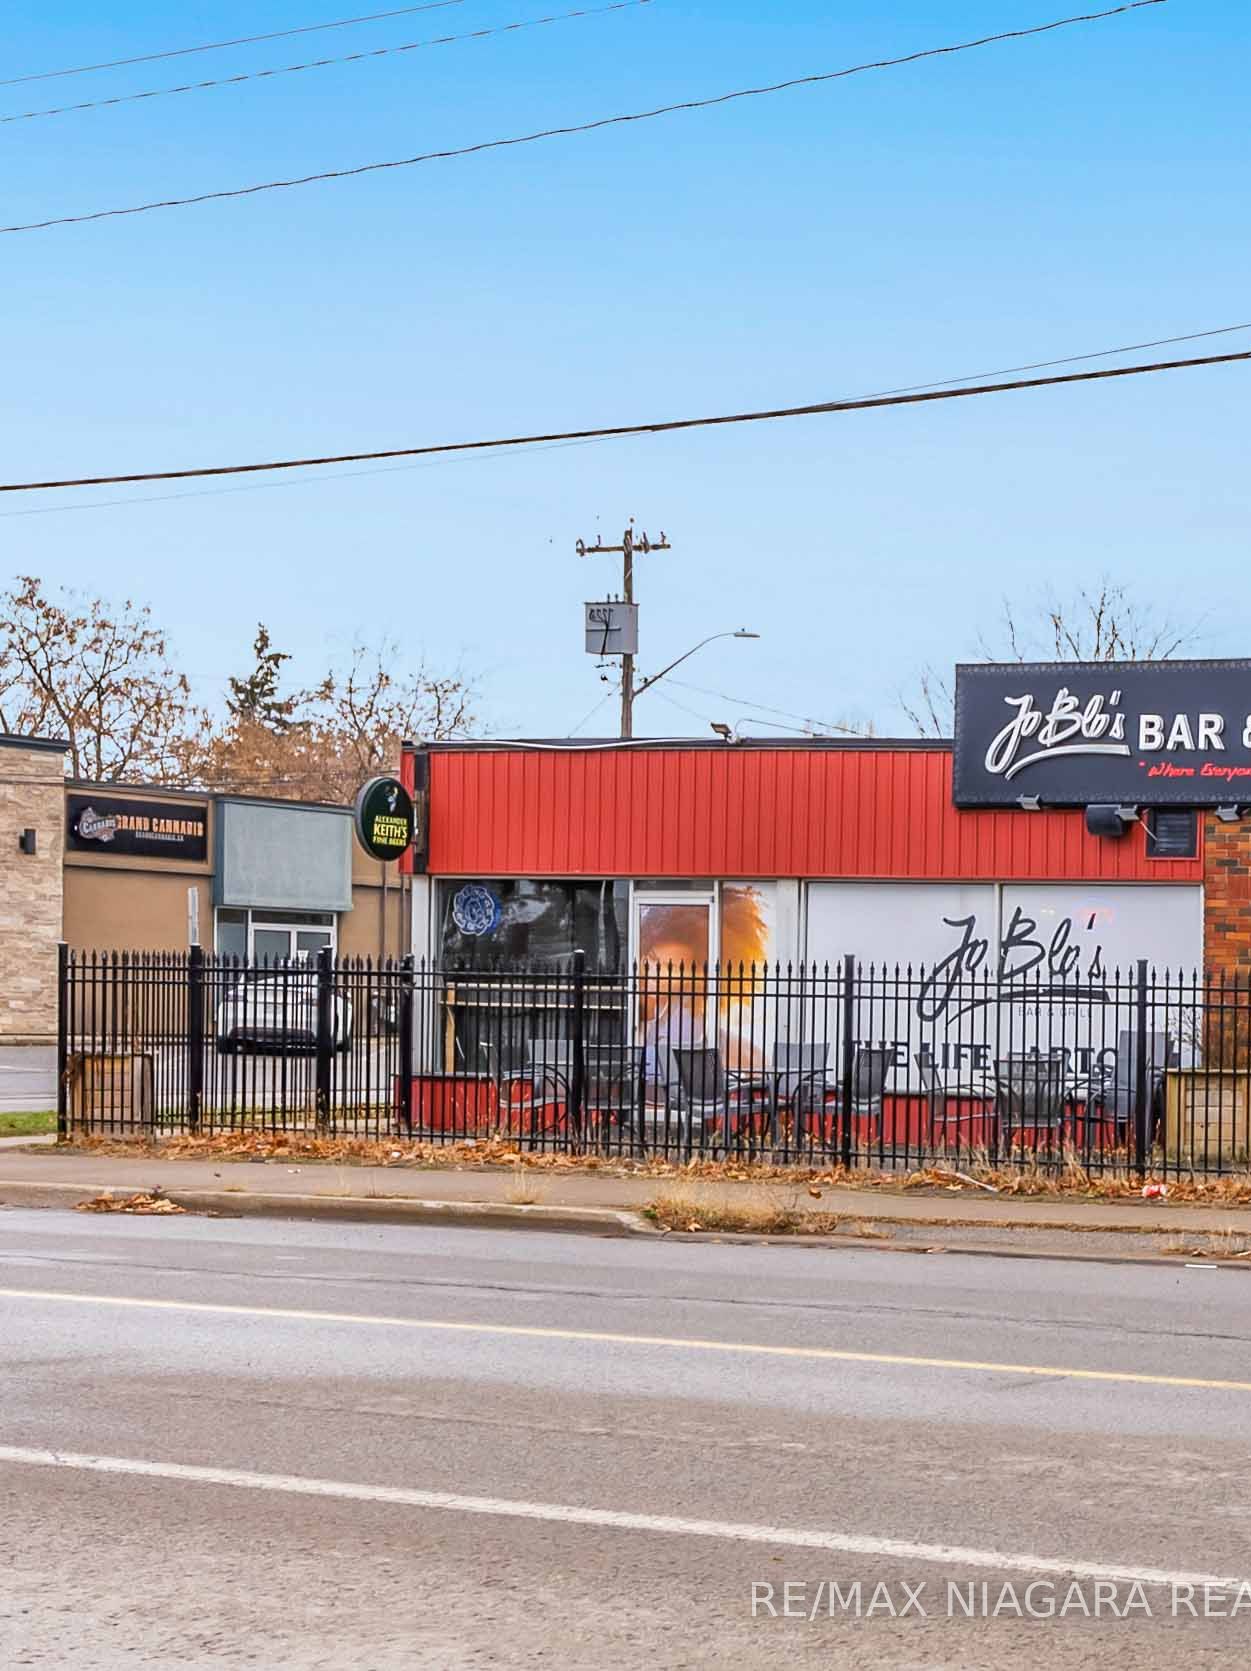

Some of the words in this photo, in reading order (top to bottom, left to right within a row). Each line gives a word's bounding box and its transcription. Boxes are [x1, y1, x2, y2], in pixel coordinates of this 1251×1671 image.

[984, 693, 1043, 774] Jo
[1037, 687, 1127, 748] Blo's
[1138, 713, 1225, 751] BAR
[152, 817, 204, 838] CANNABIS
[373, 823, 408, 839] KEITH'S
[917, 914, 989, 1022] Jo
